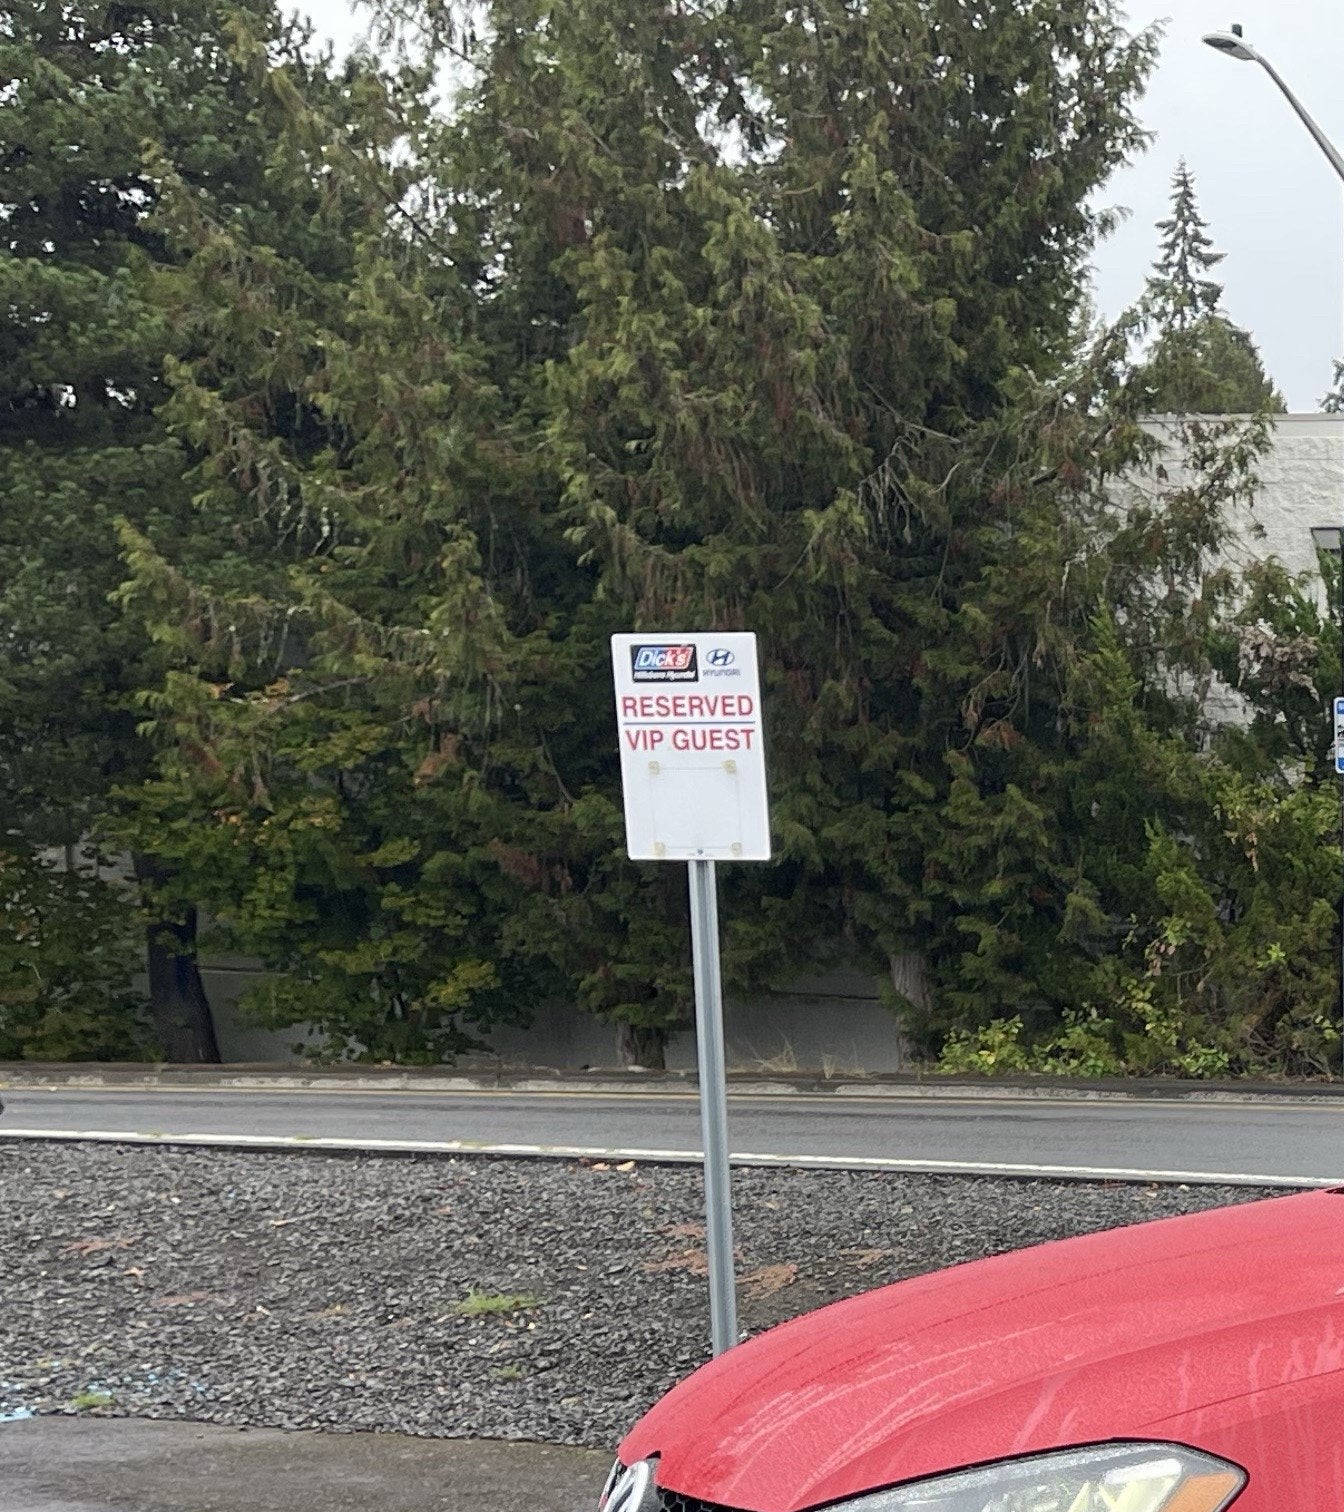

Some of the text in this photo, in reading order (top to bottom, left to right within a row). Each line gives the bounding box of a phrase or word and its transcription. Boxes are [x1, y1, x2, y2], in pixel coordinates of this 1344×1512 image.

[622, 695, 754, 718] RESERVED
[625, 729, 755, 751] VIP GUEST
